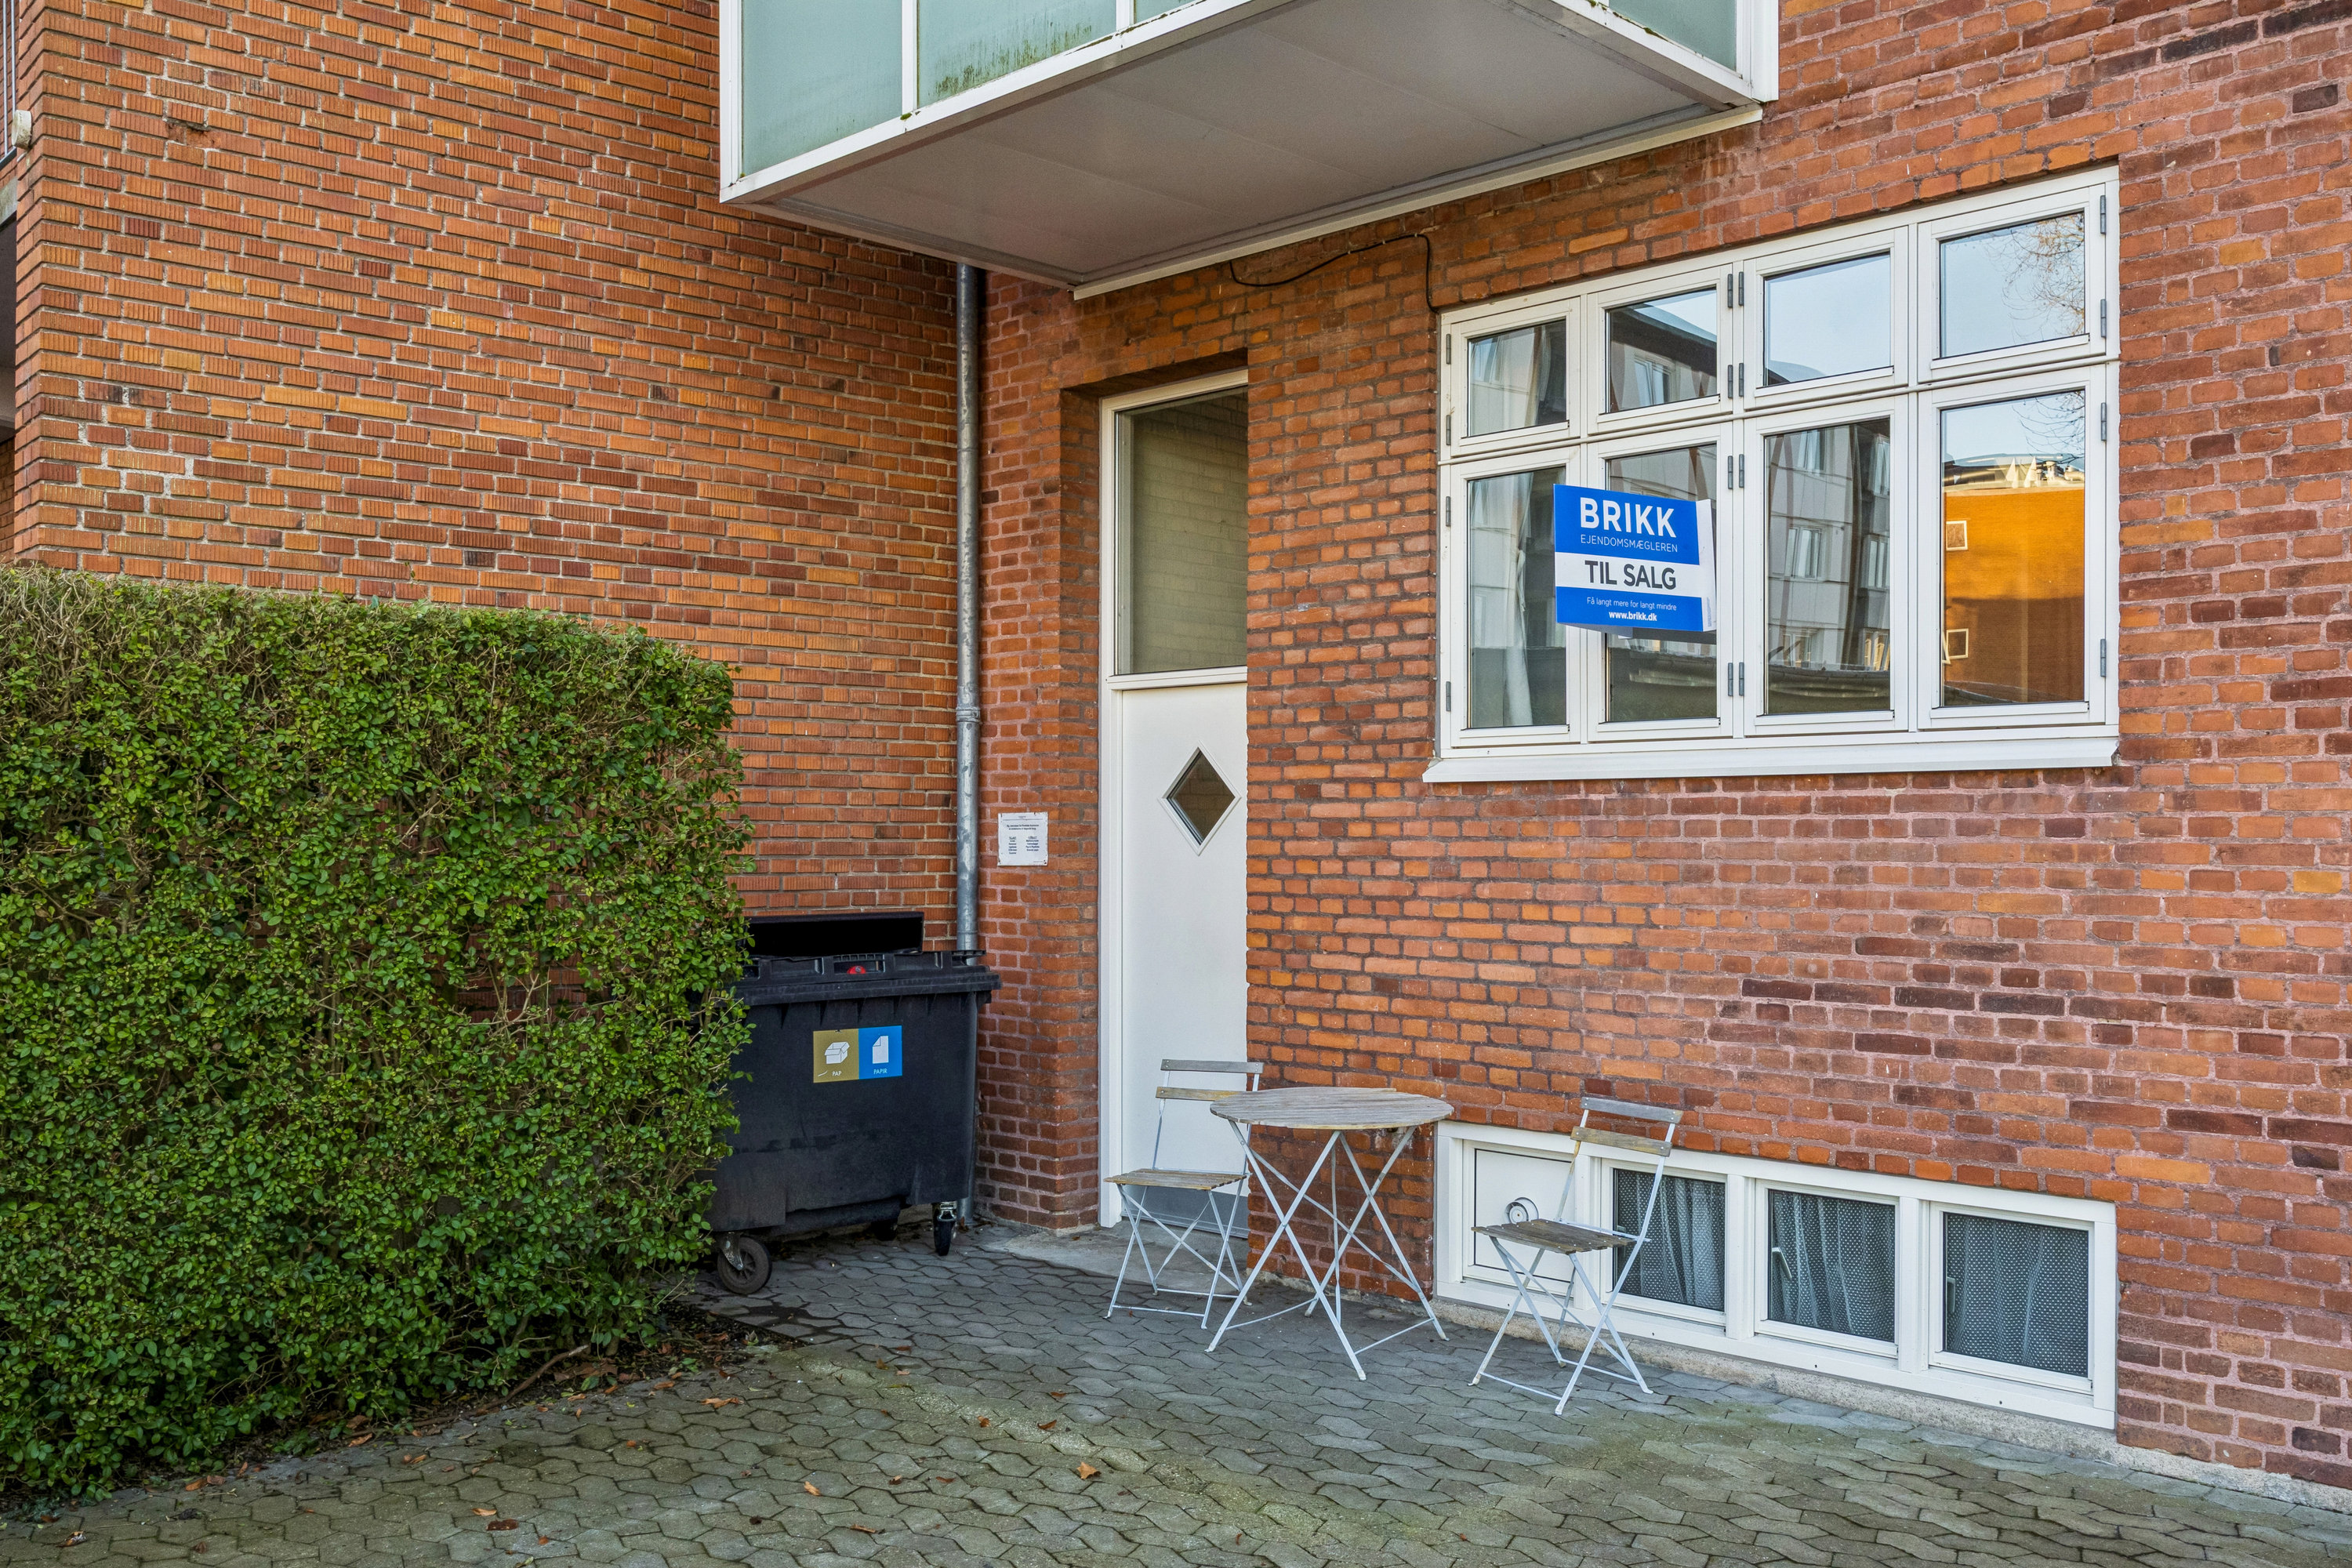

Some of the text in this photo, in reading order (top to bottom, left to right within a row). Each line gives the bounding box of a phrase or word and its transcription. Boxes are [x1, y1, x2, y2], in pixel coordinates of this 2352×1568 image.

[1580, 497, 1676, 538] BRIKK
[1581, 535, 1678, 552] EJENDOMSMÆGLEREN
[1584, 561, 1676, 590] TIL SALG
[1596, 597, 1612, 607] langt
[1640, 601, 1655, 610] langt
[1657, 602, 1677, 611] mindre
[1609, 611, 1657, 621] www.brikk.dk
